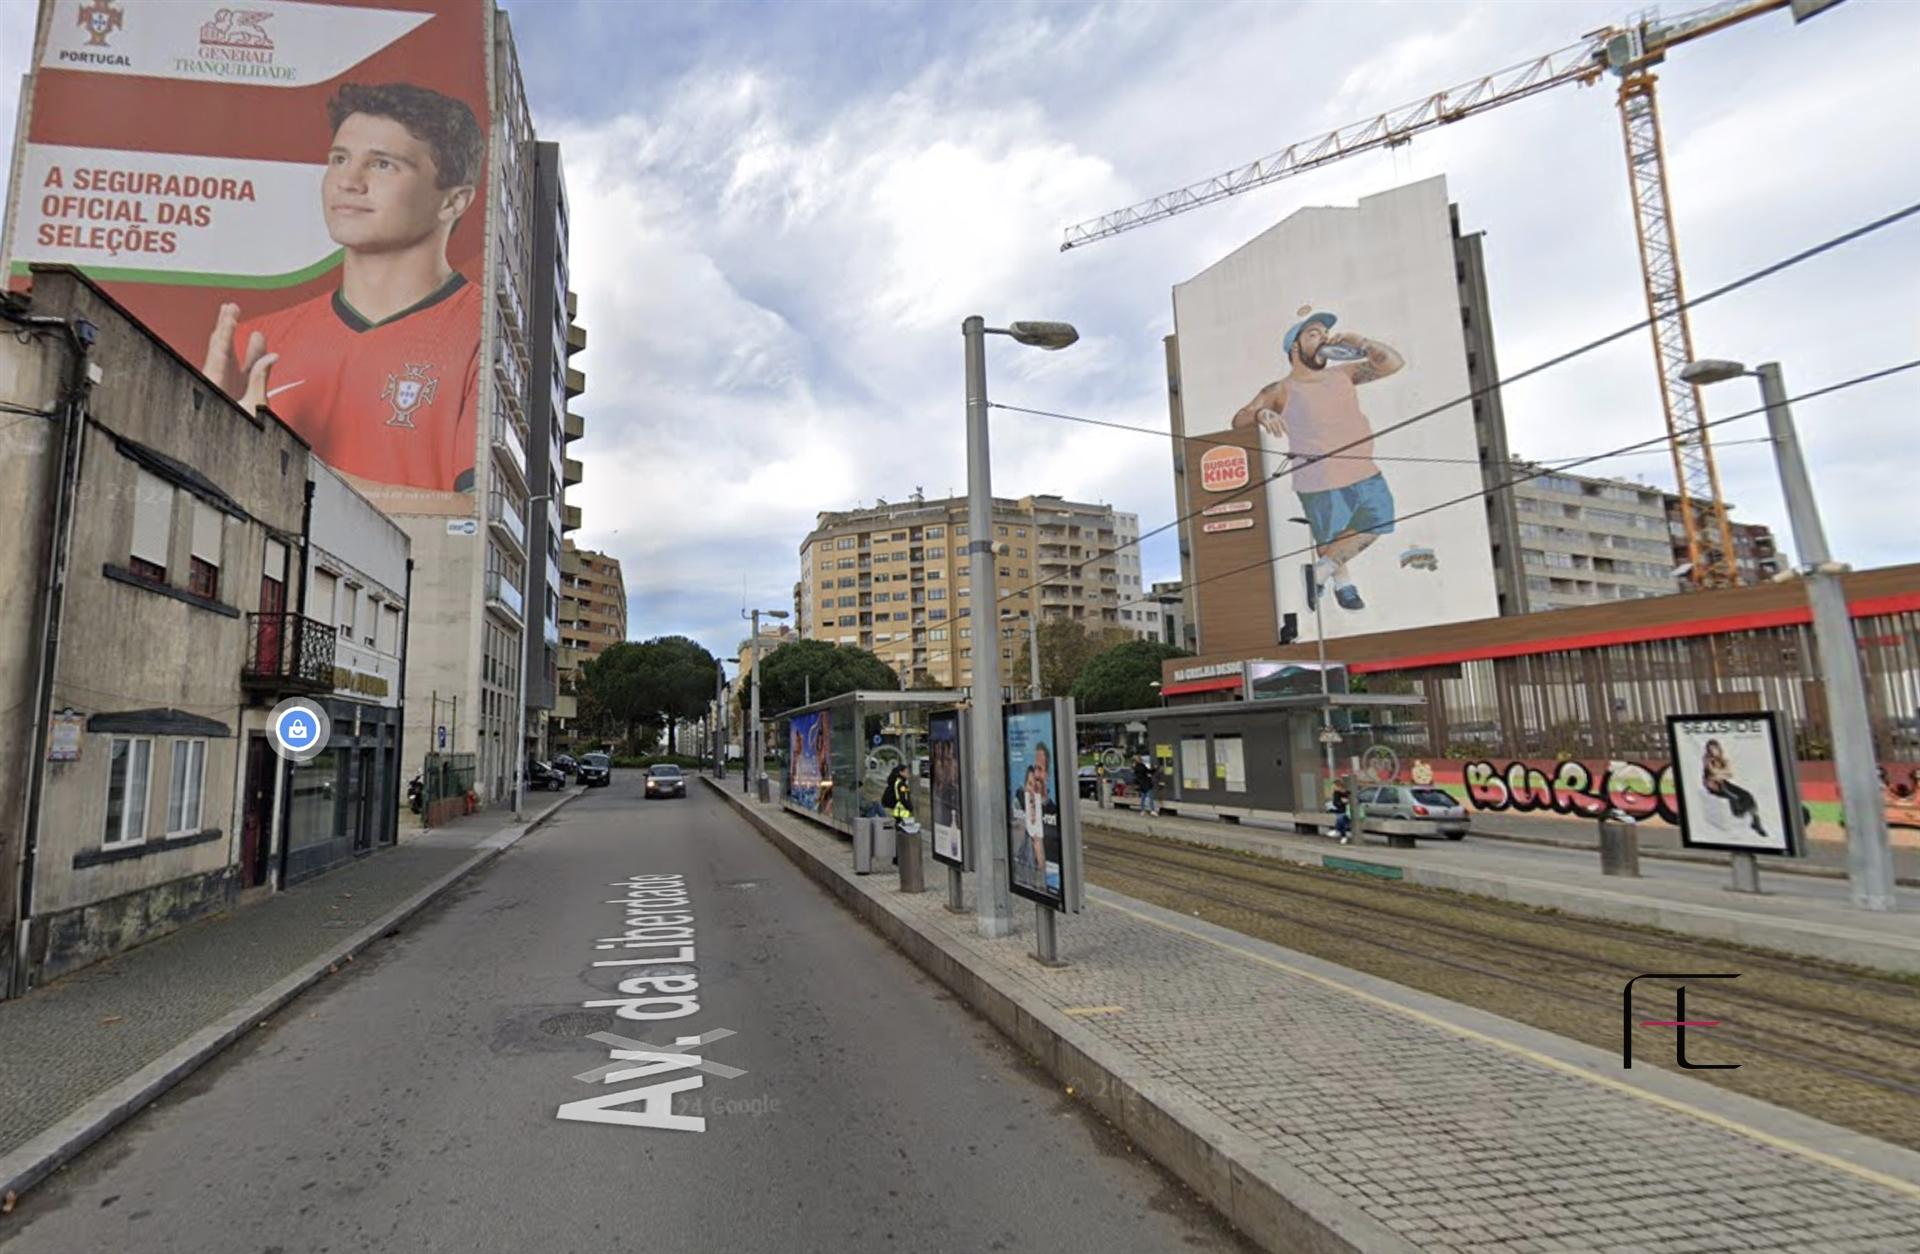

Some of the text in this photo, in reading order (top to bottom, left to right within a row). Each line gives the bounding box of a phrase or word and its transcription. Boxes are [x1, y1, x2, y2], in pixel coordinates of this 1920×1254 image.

[59, 50, 131, 67] PORTUGAL
[198, 47, 273, 64] GENERALI
[173, 58, 297, 81] TRANQUILIDADE
[44, 166, 256, 201] A SEGURADORA
[41, 194, 211, 227] OFICIAL DAS
[37, 223, 177, 256] SELEÇÕES
[1203, 458, 1246, 471] BURGER
[1204, 466, 1247, 483] KING
